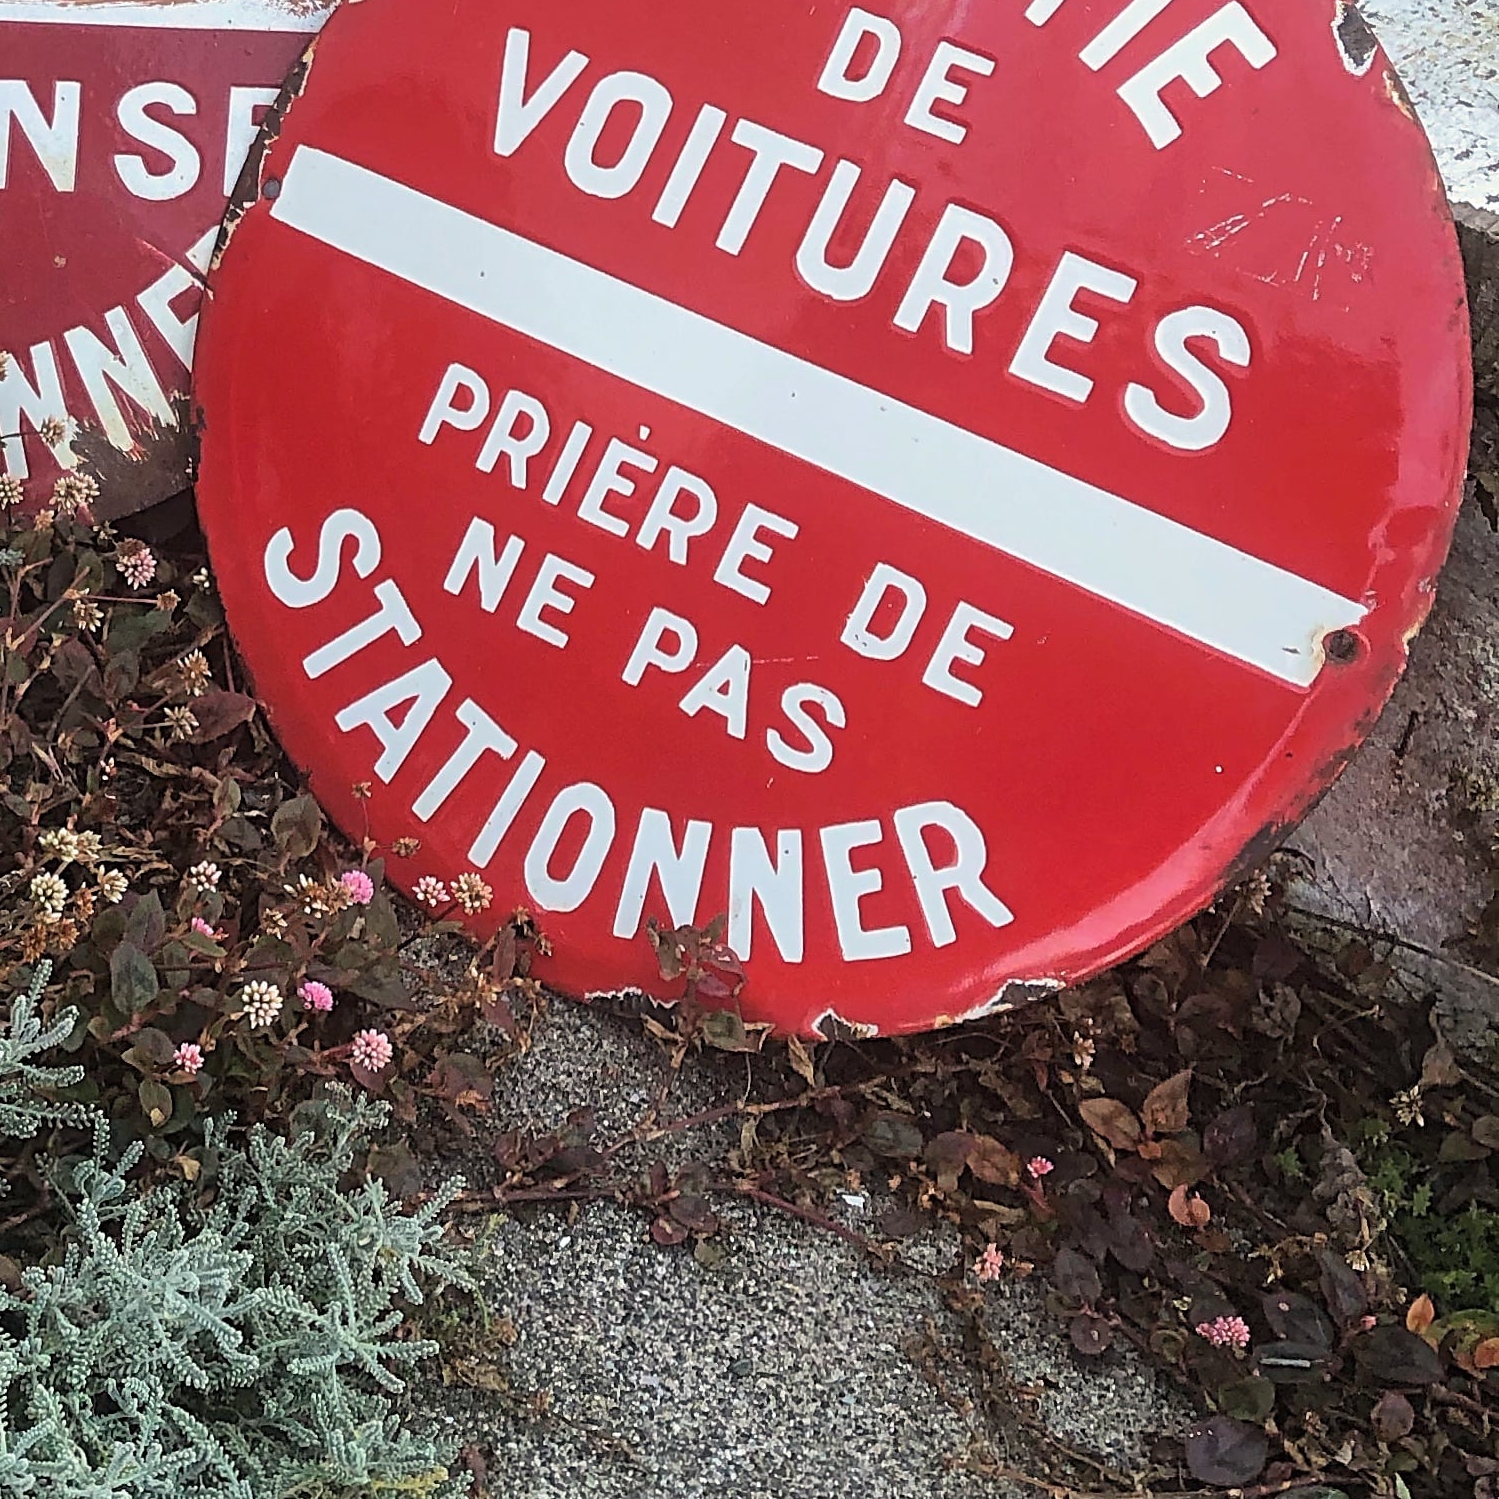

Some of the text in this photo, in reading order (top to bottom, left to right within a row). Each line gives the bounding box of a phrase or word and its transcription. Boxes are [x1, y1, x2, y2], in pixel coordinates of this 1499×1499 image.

[493, 27, 1252, 452] VOITURES
[816, 6, 996, 146] DE
[418, 362, 1015, 708] PRIÈRE DE
[443, 516, 847, 774] NE PAS
[263, 507, 1014, 963] STATIONNER
